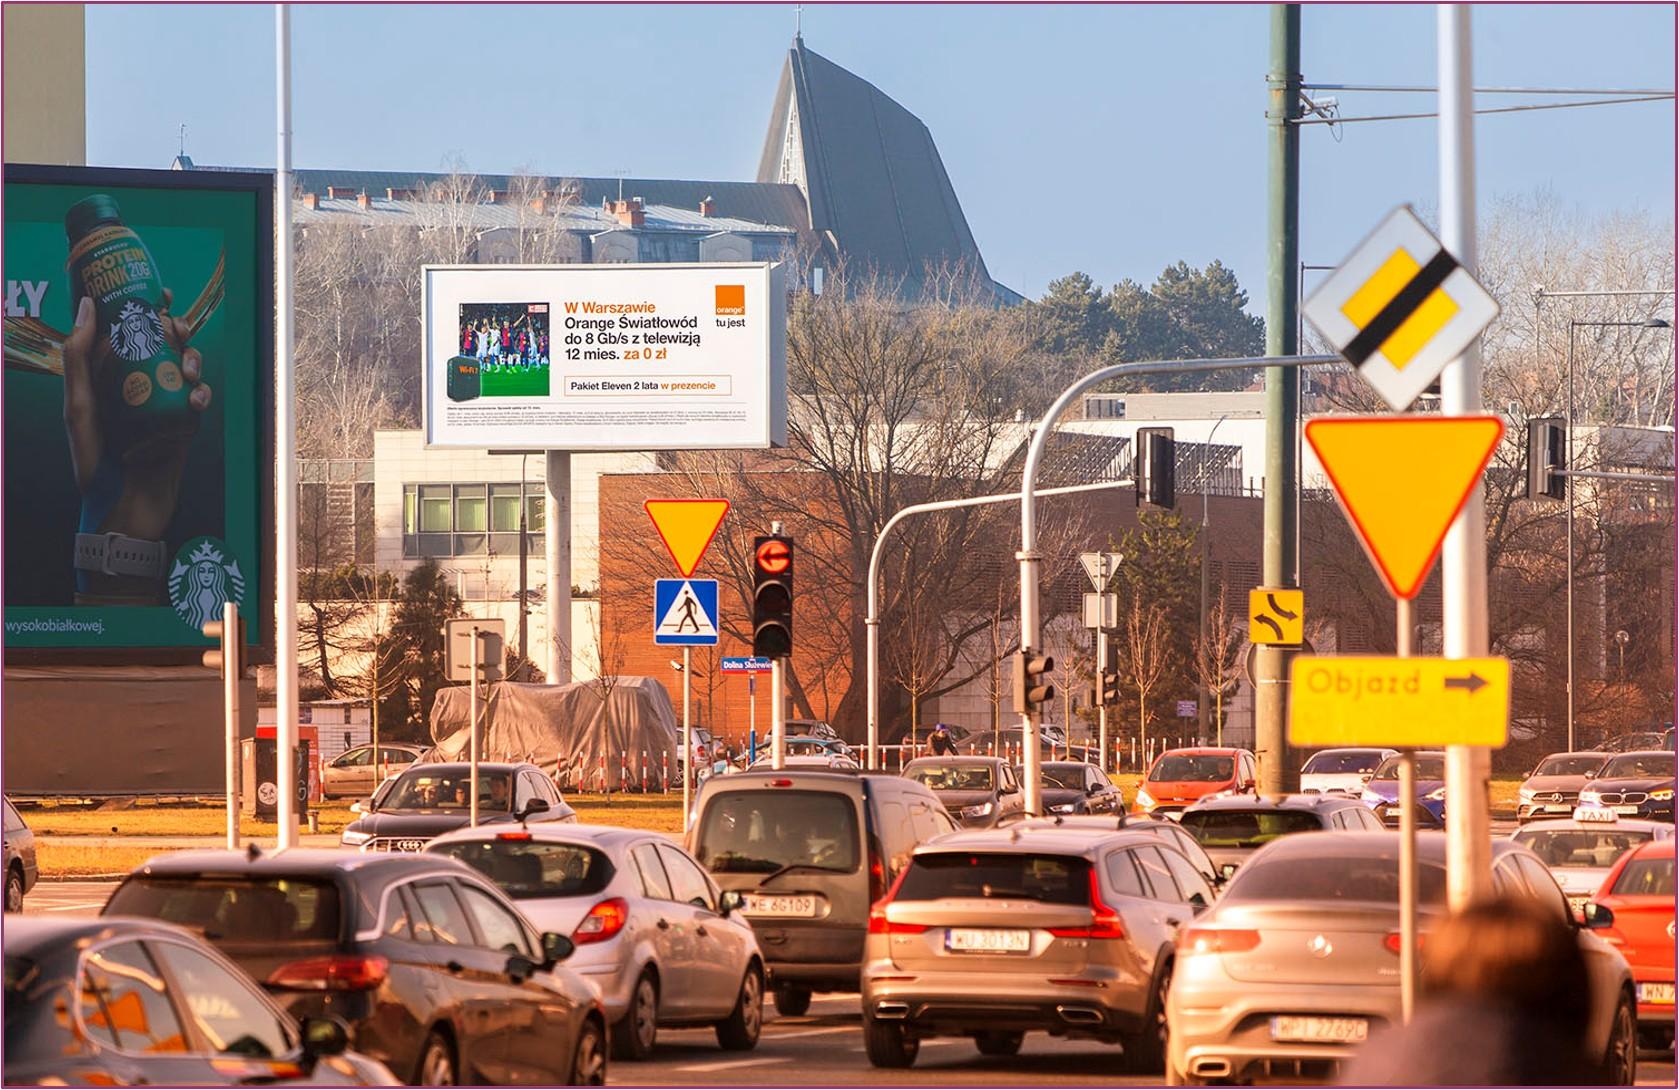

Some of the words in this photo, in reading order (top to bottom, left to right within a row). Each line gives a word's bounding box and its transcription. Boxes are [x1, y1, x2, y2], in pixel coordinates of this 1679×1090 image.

[80, 247, 148, 283] PROTEIN
[85, 265, 131, 299] DRINK
[127, 261, 152, 279] 20G
[4, 280, 49, 317] ŁY
[101, 288, 123, 304] WITH
[122, 282, 148, 295] COFFEE
[564, 302, 579, 314] W
[582, 301, 656, 314] Warszawie
[716, 306, 743, 315] orange
[564, 316, 615, 331] Orange
[618, 314, 698, 329] Światłowód
[716, 318, 726, 328] tu
[726, 318, 746, 329] jest
[564, 333, 582, 345] do
[585, 333, 594, 345] 8
[597, 332, 629, 345] Gb/s
[632, 336, 640, 345] z
[643, 332, 701, 347] telewizją
[565, 348, 581, 360] 12
[584, 348, 620, 360] mies.
[623, 350, 640, 360] za
[643, 348, 651, 360] 0
[655, 347, 667, 360] zł
[570, 381, 599, 391] Pakiet
[601, 381, 632, 390] Eleven
[634, 381, 640, 390] 2
[642, 381, 659, 390] lata
[671, 381, 716, 392] prezencie
[5, 618, 105, 634] wysokobiałkowej.
[723, 661, 744, 669] Dolina
[1307, 668, 1421, 701] Objazd
[1581, 811, 1609, 821] TAXI
[1646, 985, 1664, 998] WN
